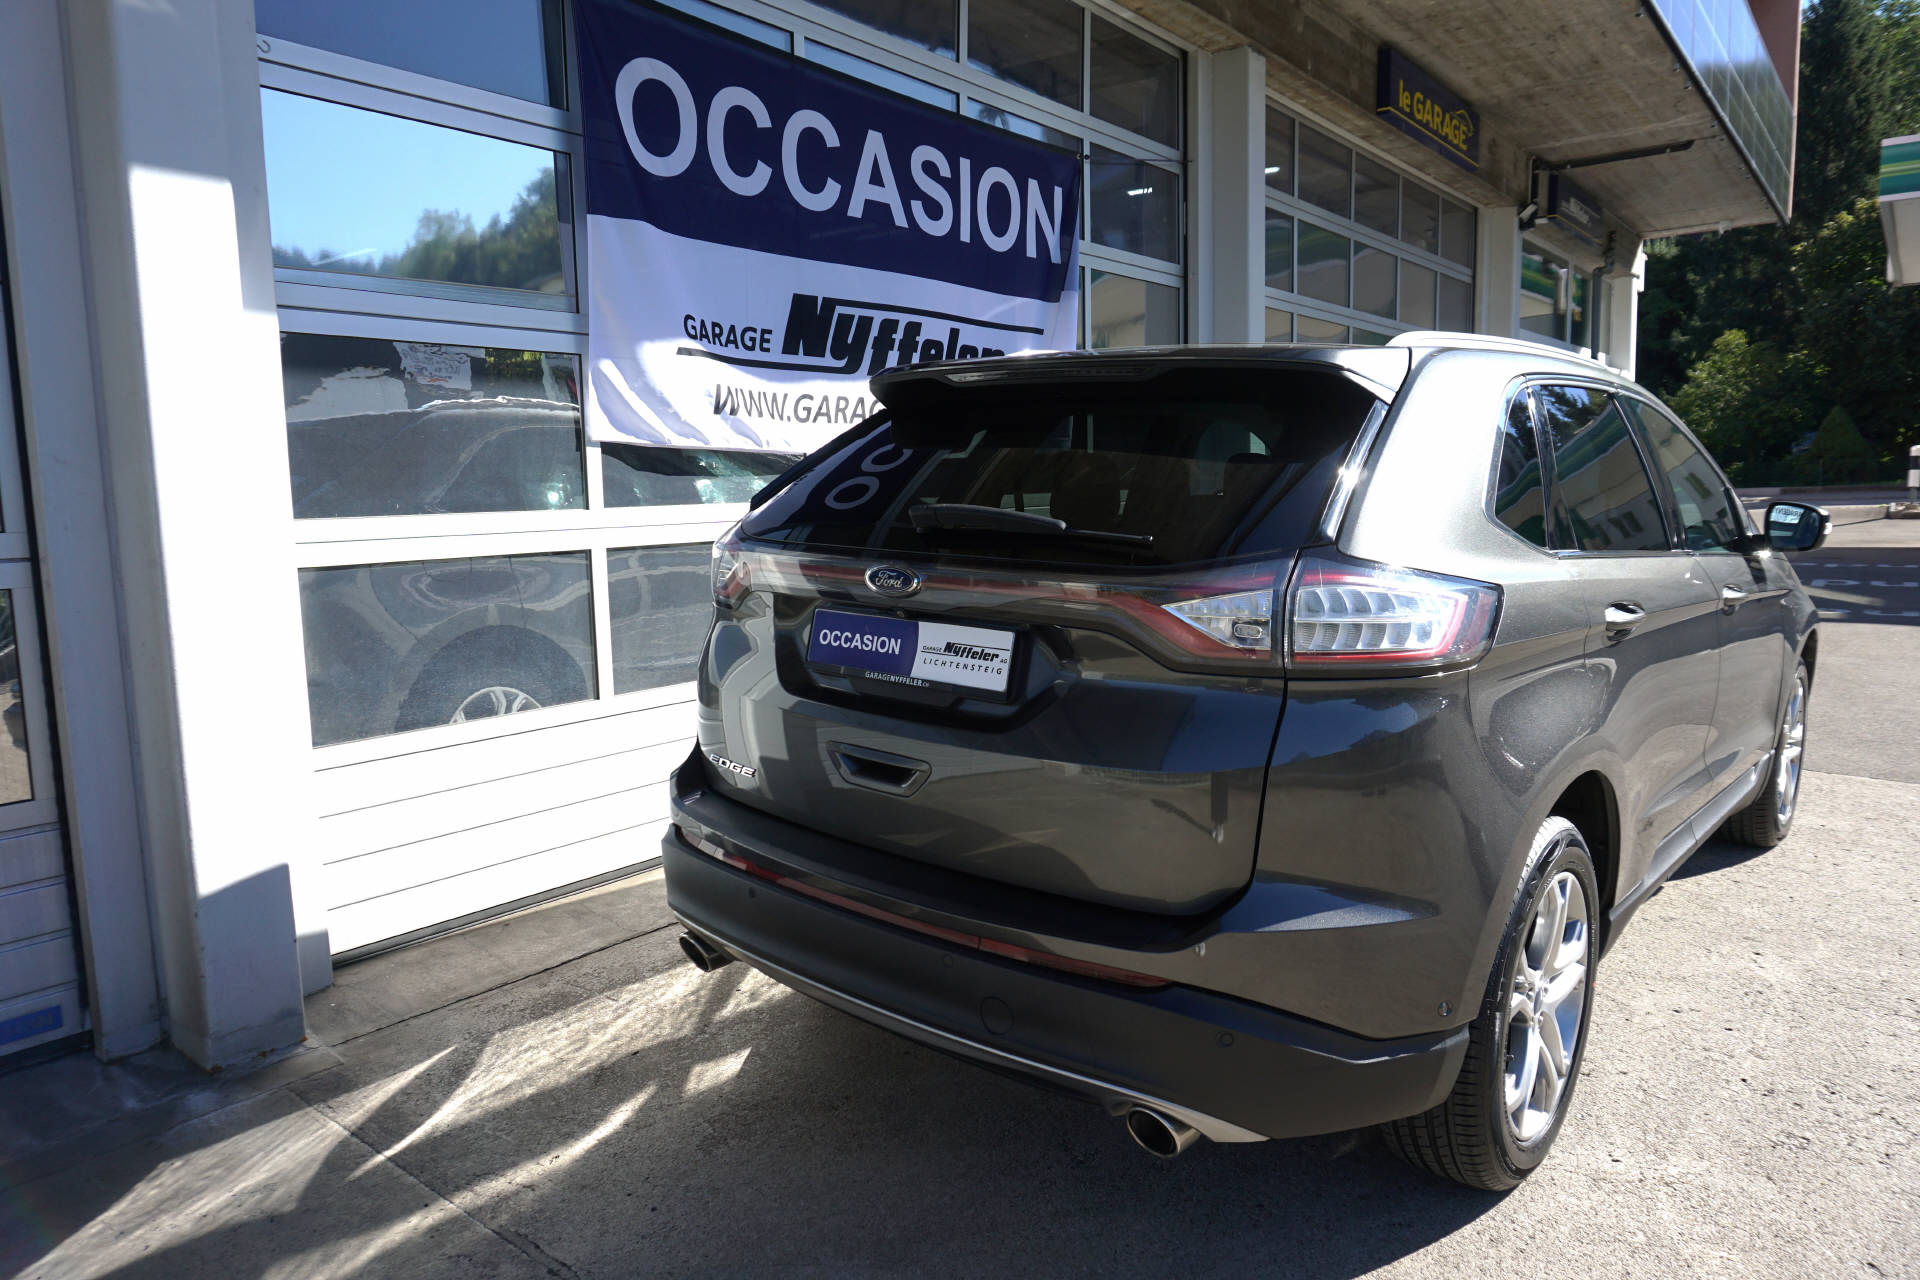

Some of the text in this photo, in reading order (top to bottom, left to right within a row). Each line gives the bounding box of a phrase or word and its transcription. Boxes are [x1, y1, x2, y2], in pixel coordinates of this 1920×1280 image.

[1399, 79, 1468, 151] le GARAGE
[614, 56, 1063, 265] OCCASION
[683, 292, 1005, 376] GARAGE Nyffel
[875, 570, 904, 588] Ford
[819, 629, 902, 655] OCCASION
[922, 645, 943, 653] GARAGE
[943, 641, 1000, 662] Nyffeler
[923, 657, 1003, 675] LICHTENSTEIG
[709, 753, 757, 778] EDGE
